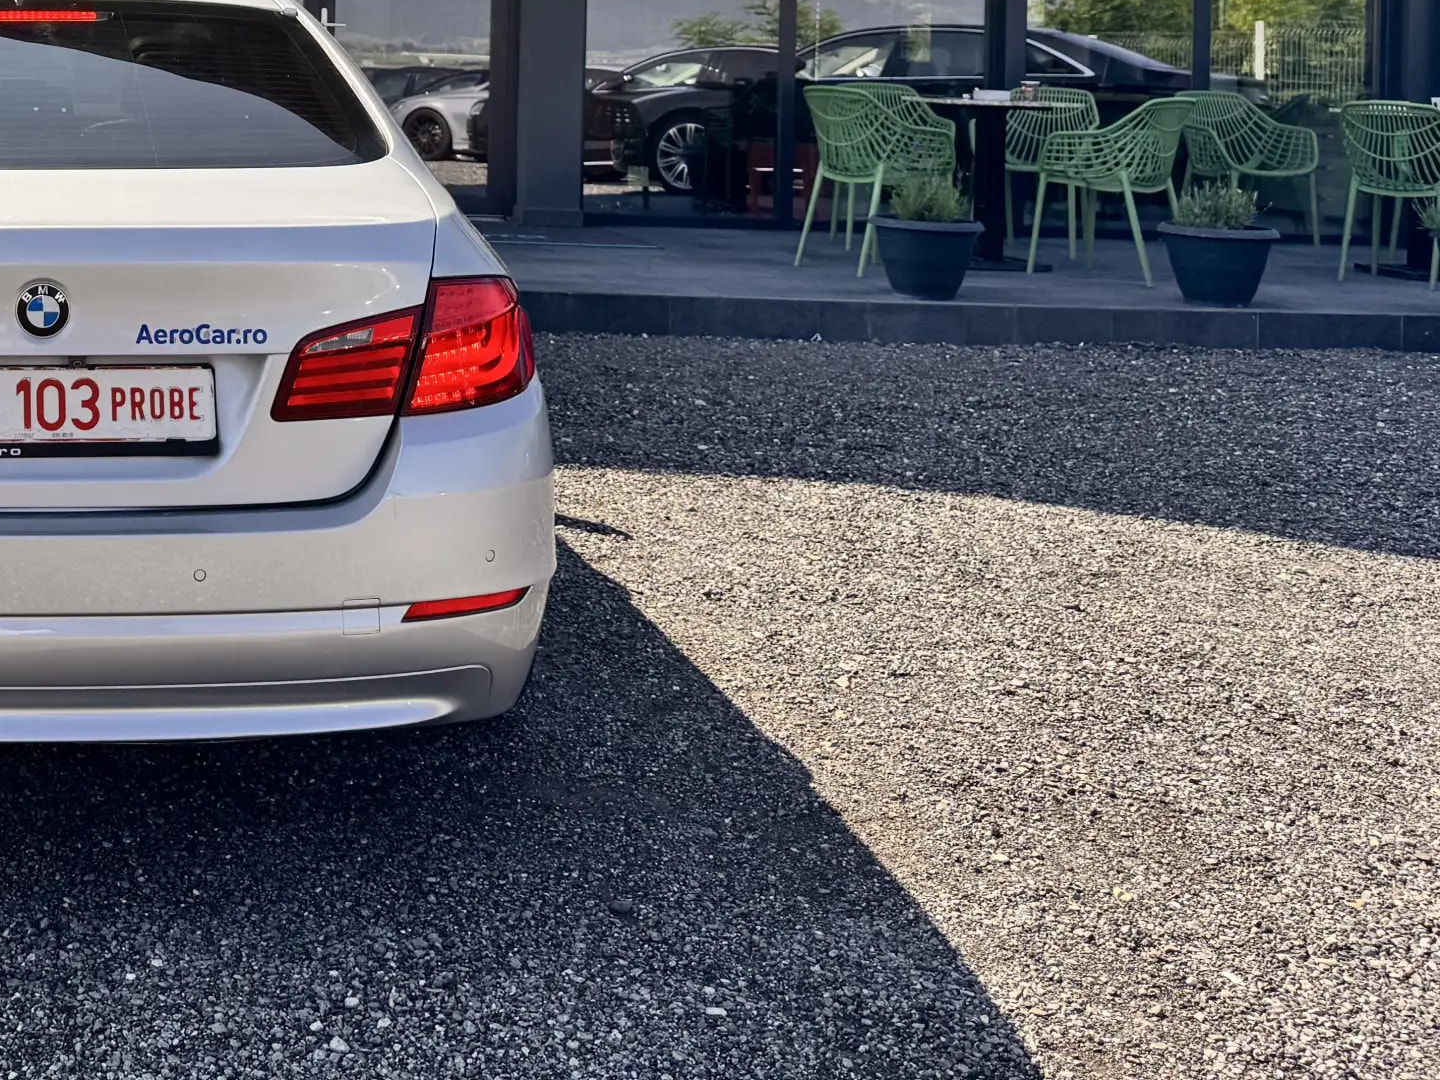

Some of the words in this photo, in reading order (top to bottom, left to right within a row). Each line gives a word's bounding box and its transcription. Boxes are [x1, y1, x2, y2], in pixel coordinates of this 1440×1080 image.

[21, 285, 66, 304] BMW
[135, 323, 268, 346] AeroCar.ro
[15, 377, 100, 431] 103
[111, 386, 201, 422] PROBE
